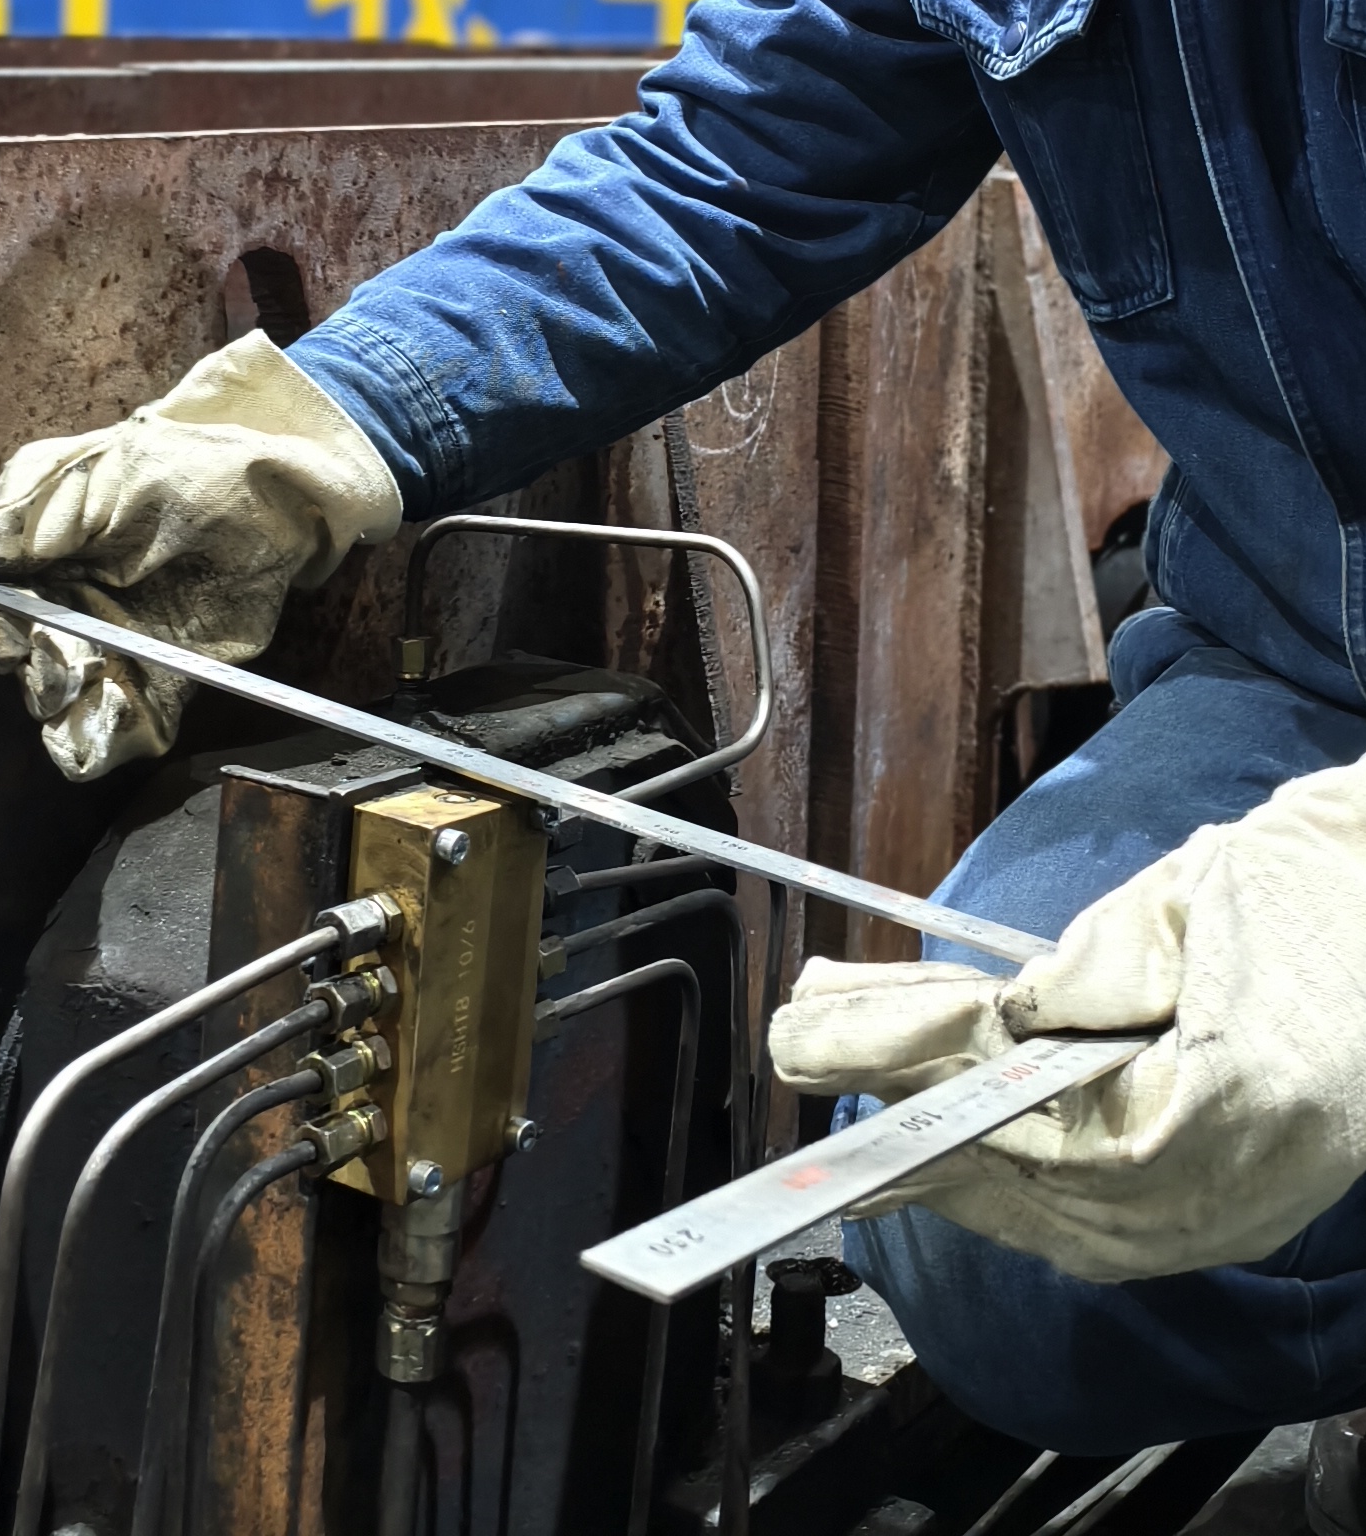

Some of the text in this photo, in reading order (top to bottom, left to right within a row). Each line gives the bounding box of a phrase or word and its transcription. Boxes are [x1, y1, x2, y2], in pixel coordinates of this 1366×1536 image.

[1002, 1062, 1040, 1080] 100
[899, 1110, 943, 1132] 150
[648, 1229, 705, 1256] 250
